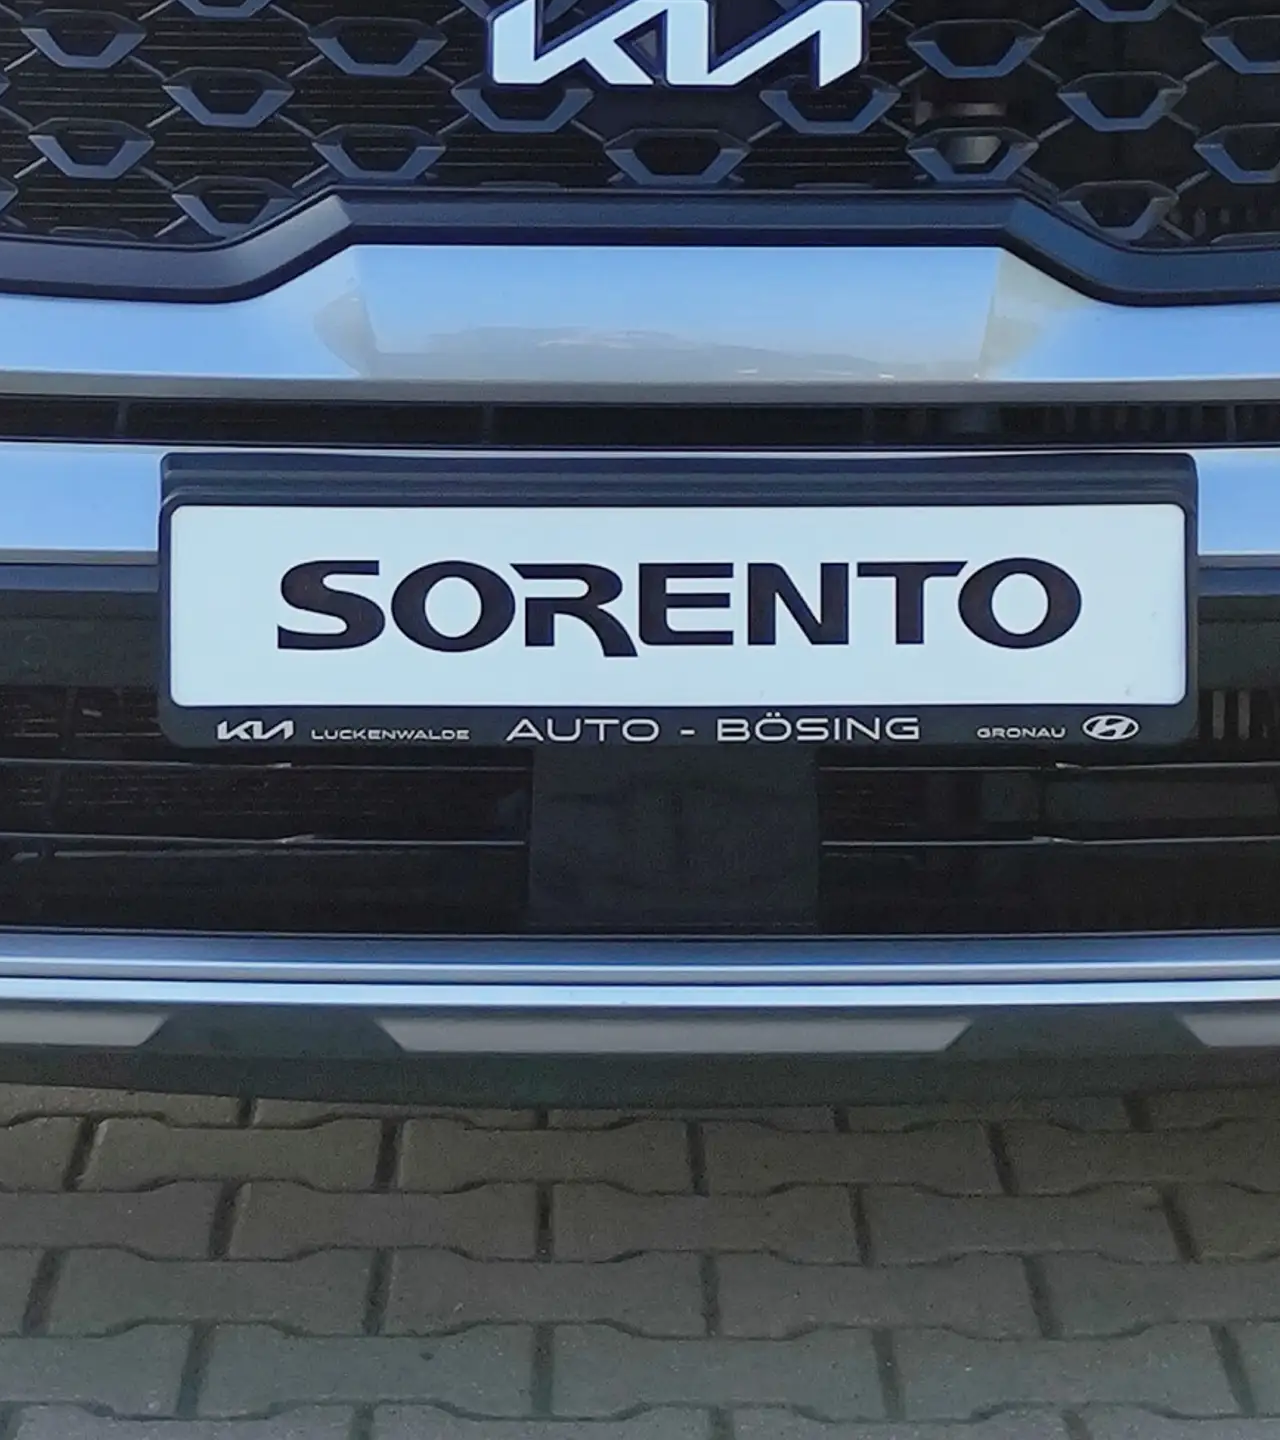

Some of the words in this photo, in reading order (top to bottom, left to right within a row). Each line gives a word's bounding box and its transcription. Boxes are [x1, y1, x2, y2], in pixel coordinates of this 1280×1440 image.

[277, 557, 1083, 658] SORENTO
[311, 727, 471, 741] LUCKENWALDE
[505, 717, 660, 743] AUTO
[716, 711, 920, 742] BÖSING
[976, 726, 1067, 740] GRONAU
